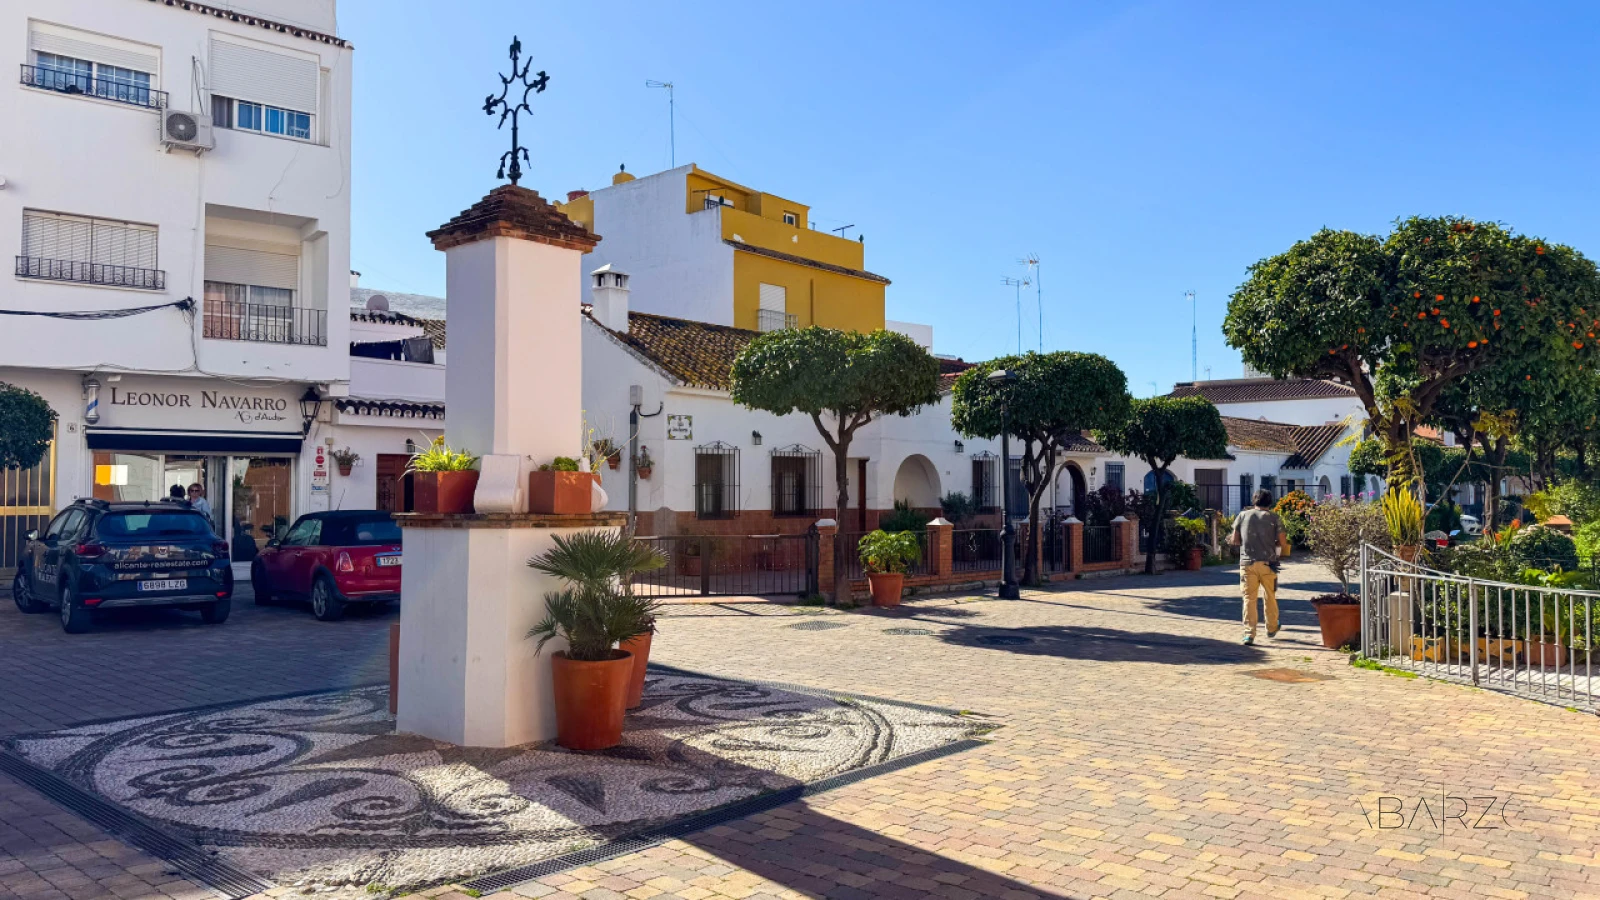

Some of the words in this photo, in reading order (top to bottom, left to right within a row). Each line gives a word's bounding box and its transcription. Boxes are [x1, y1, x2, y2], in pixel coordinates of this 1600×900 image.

[110, 387, 191, 407] LEONOR
[201, 390, 287, 411] NAVARRO
[114, 559, 209, 570] alicante-realestate.com
